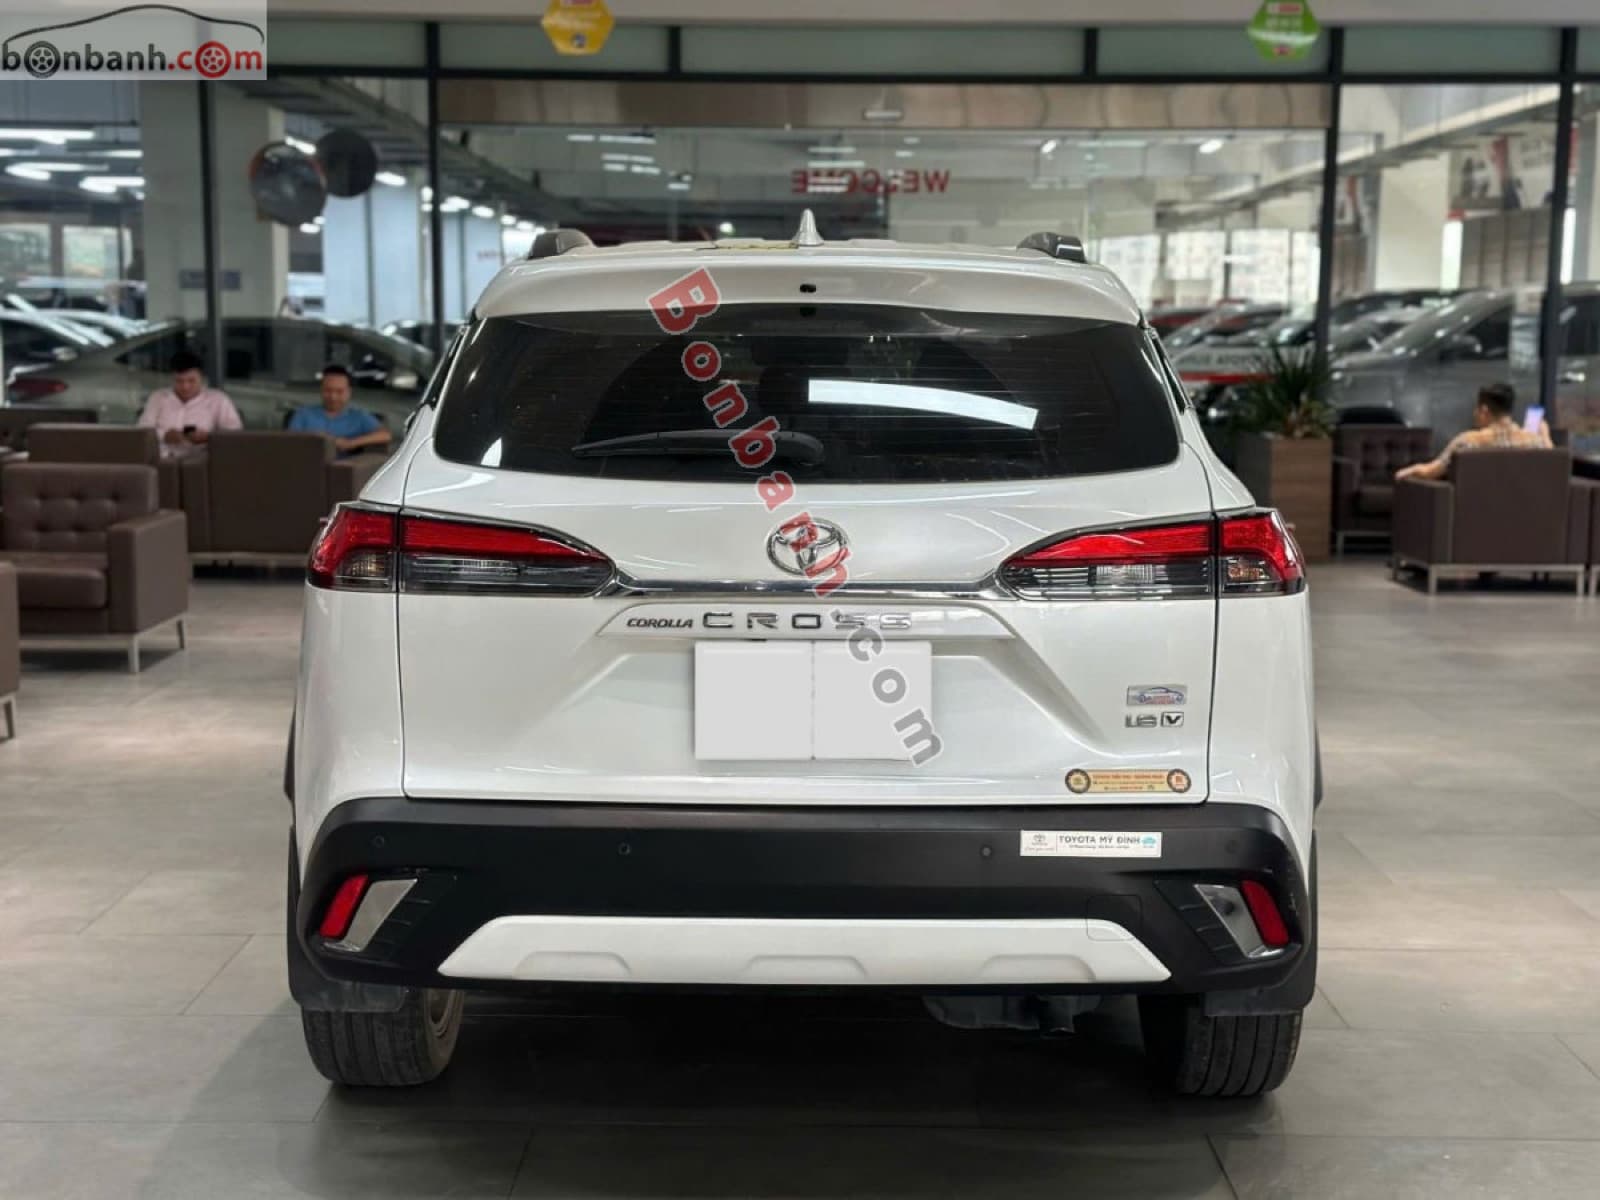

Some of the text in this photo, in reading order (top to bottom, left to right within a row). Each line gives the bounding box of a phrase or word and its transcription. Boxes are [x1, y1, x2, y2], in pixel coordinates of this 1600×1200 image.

[626, 611, 912, 630] COROLLA CROSS
[1059, 835, 1097, 844] TOYOTA
